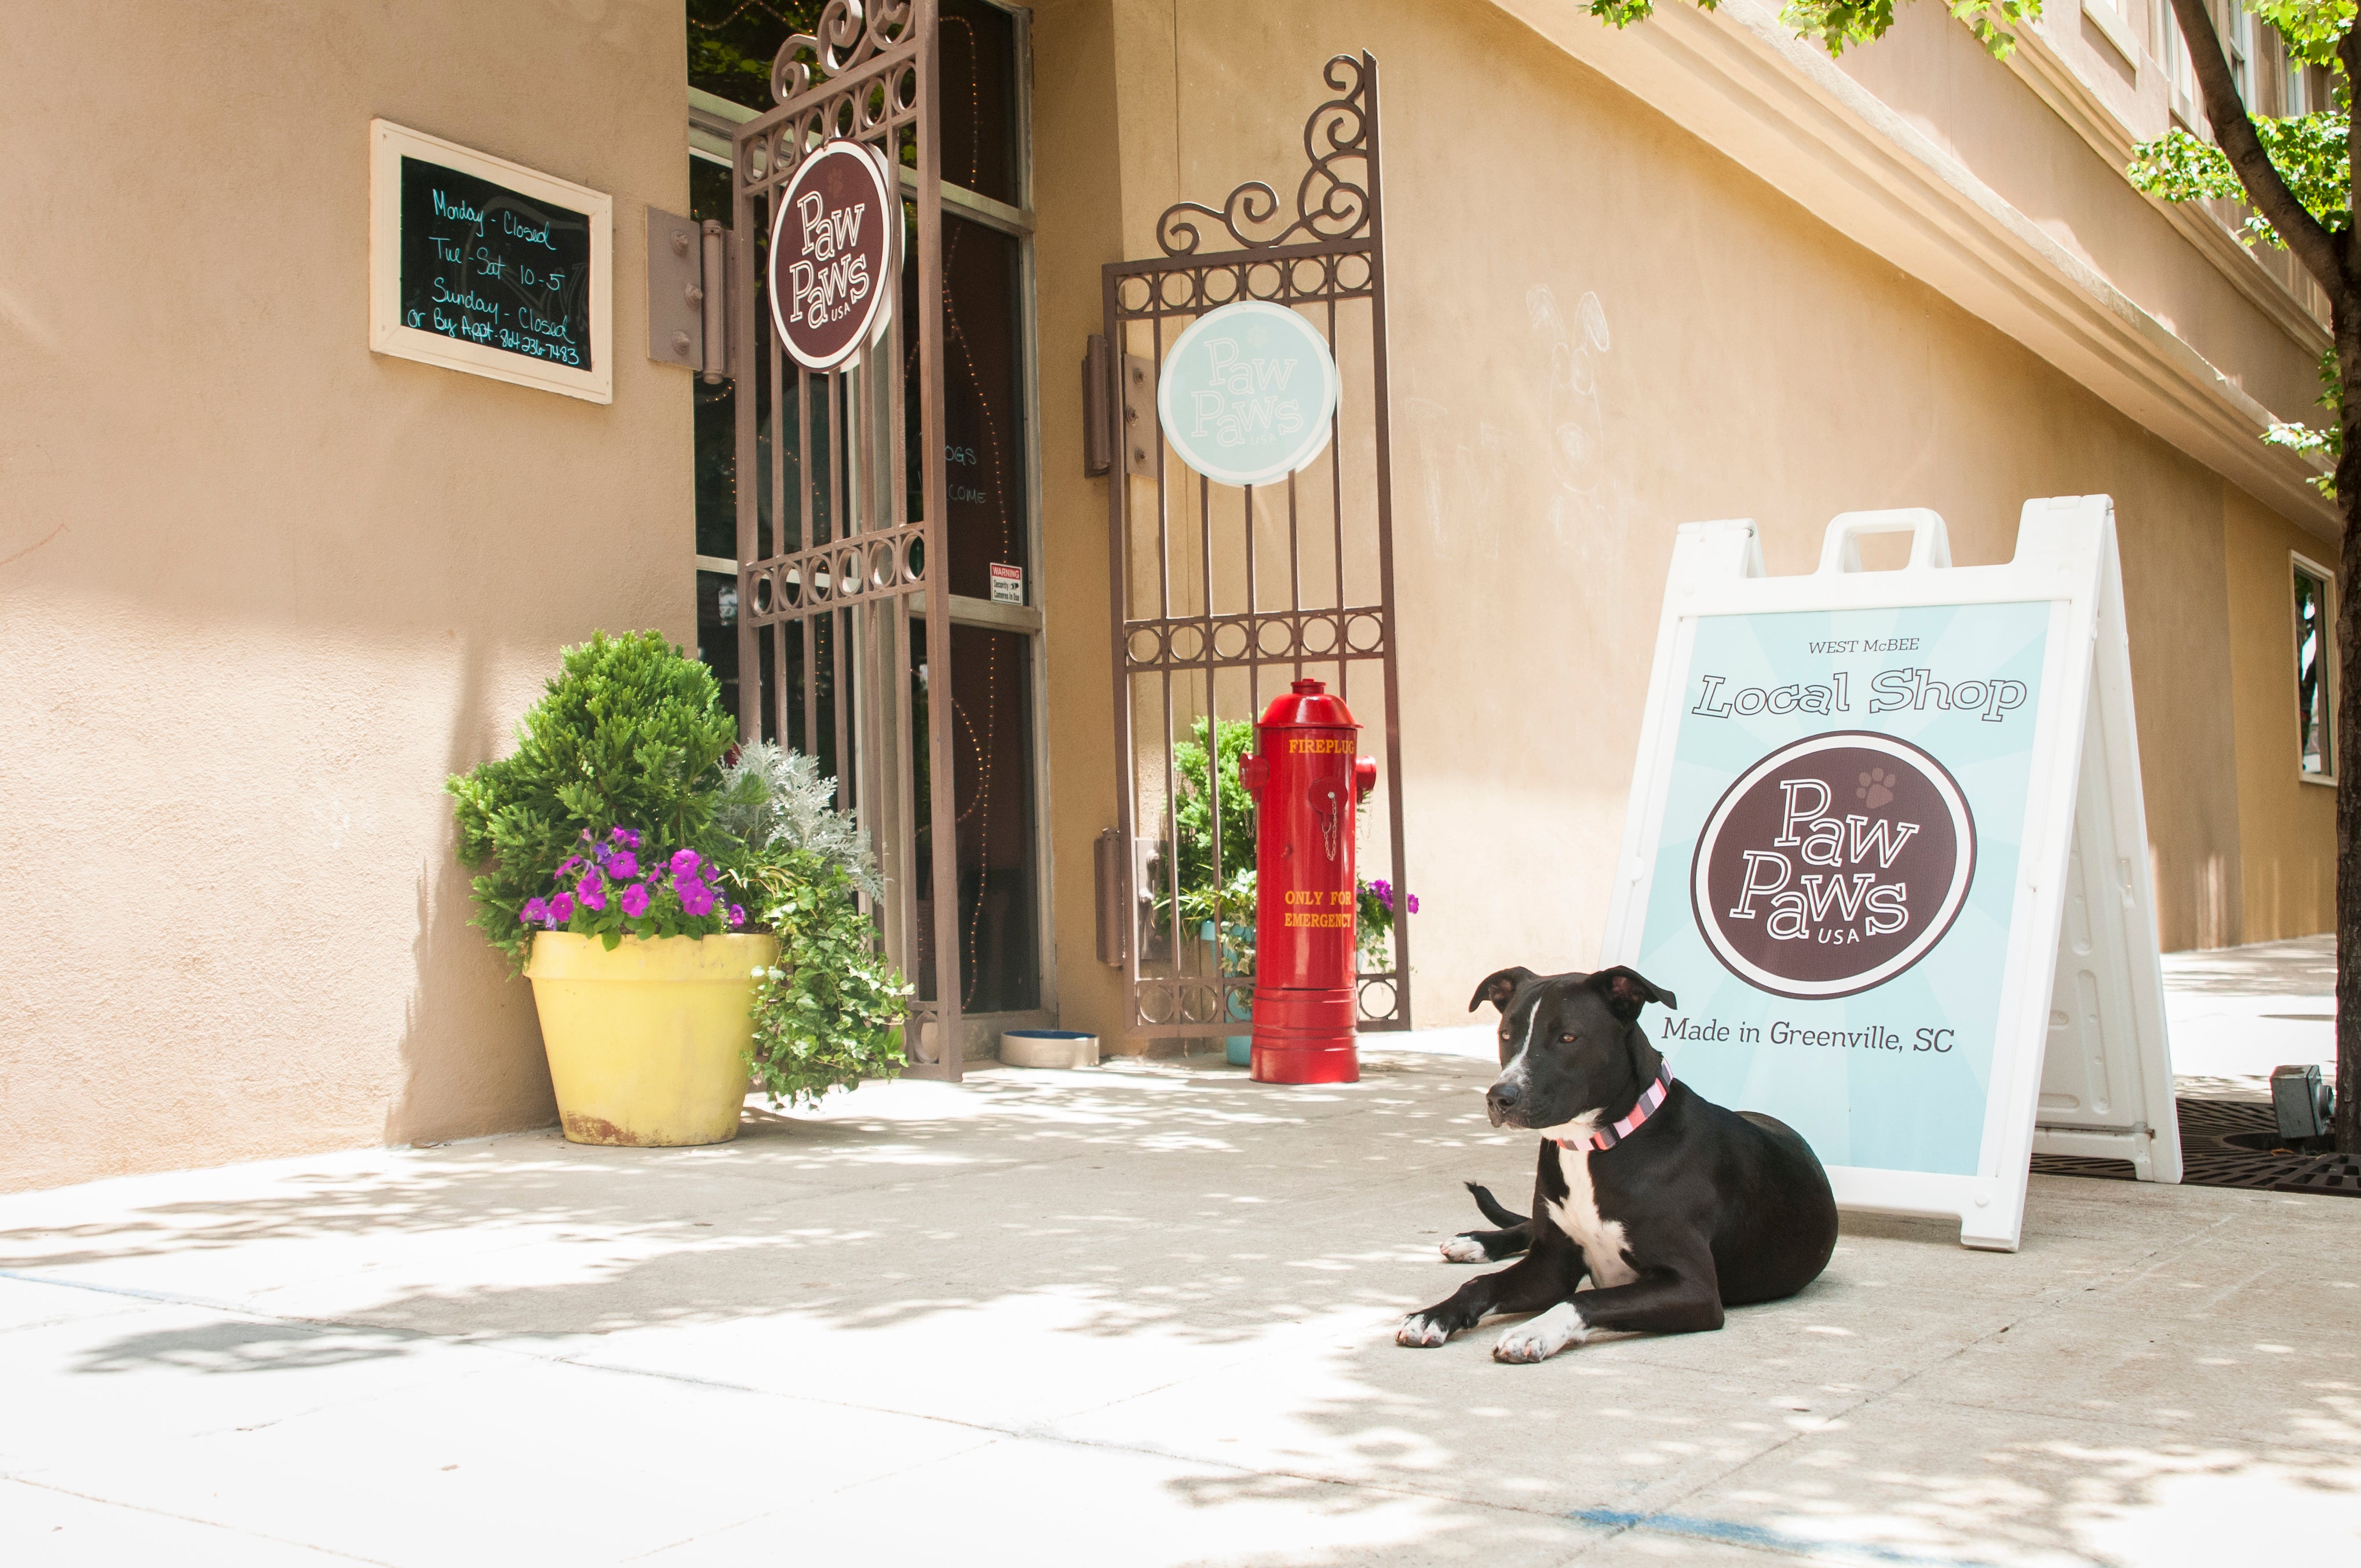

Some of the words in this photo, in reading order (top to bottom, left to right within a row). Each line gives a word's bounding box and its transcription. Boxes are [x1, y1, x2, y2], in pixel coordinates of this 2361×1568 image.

[433, 189, 484, 237] Monday
[503, 211, 557, 250] Closed
[797, 191, 864, 261] Paw
[429, 236, 462, 264] Tue
[477, 247, 505, 279] Sat
[789, 253, 869, 329] Paws
[432, 277, 499, 324] Sunday
[519, 307, 575, 344] Closed
[434, 308, 457, 338] By
[831, 302, 851, 321] USA
[1203, 337, 1297, 395] Paw
[1191, 390, 1303, 447] Paws
[1251, 433, 1277, 446] USA
[945, 445, 976, 465] OGS
[946, 484, 986, 504] COME
[992, 566, 1020, 579] WARNING
[994, 579, 1008, 591] Security
[994, 590, 1009, 600] Cameras
[1808, 640, 1858, 655] WEST
[1863, 637, 1920, 653] McBEE
[1691, 672, 1849, 718] Local
[1869, 667, 2027, 722] Shop
[1289, 739, 1355, 754] FIREPLUG
[1774, 778, 1920, 869] Paw
[1284, 890, 1324, 906] ONLY
[1330, 890, 1352, 906] FOR
[1729, 849, 1908, 940] Paws
[1284, 913, 1352, 928] EMERGENCY
[1818, 928, 1859, 945] USA
[1661, 1017, 1730, 1042] Made
[1739, 1021, 1760, 1043] in
[1770, 1021, 1903, 1053] Greenville,
[1913, 1028, 1955, 1053] SC
